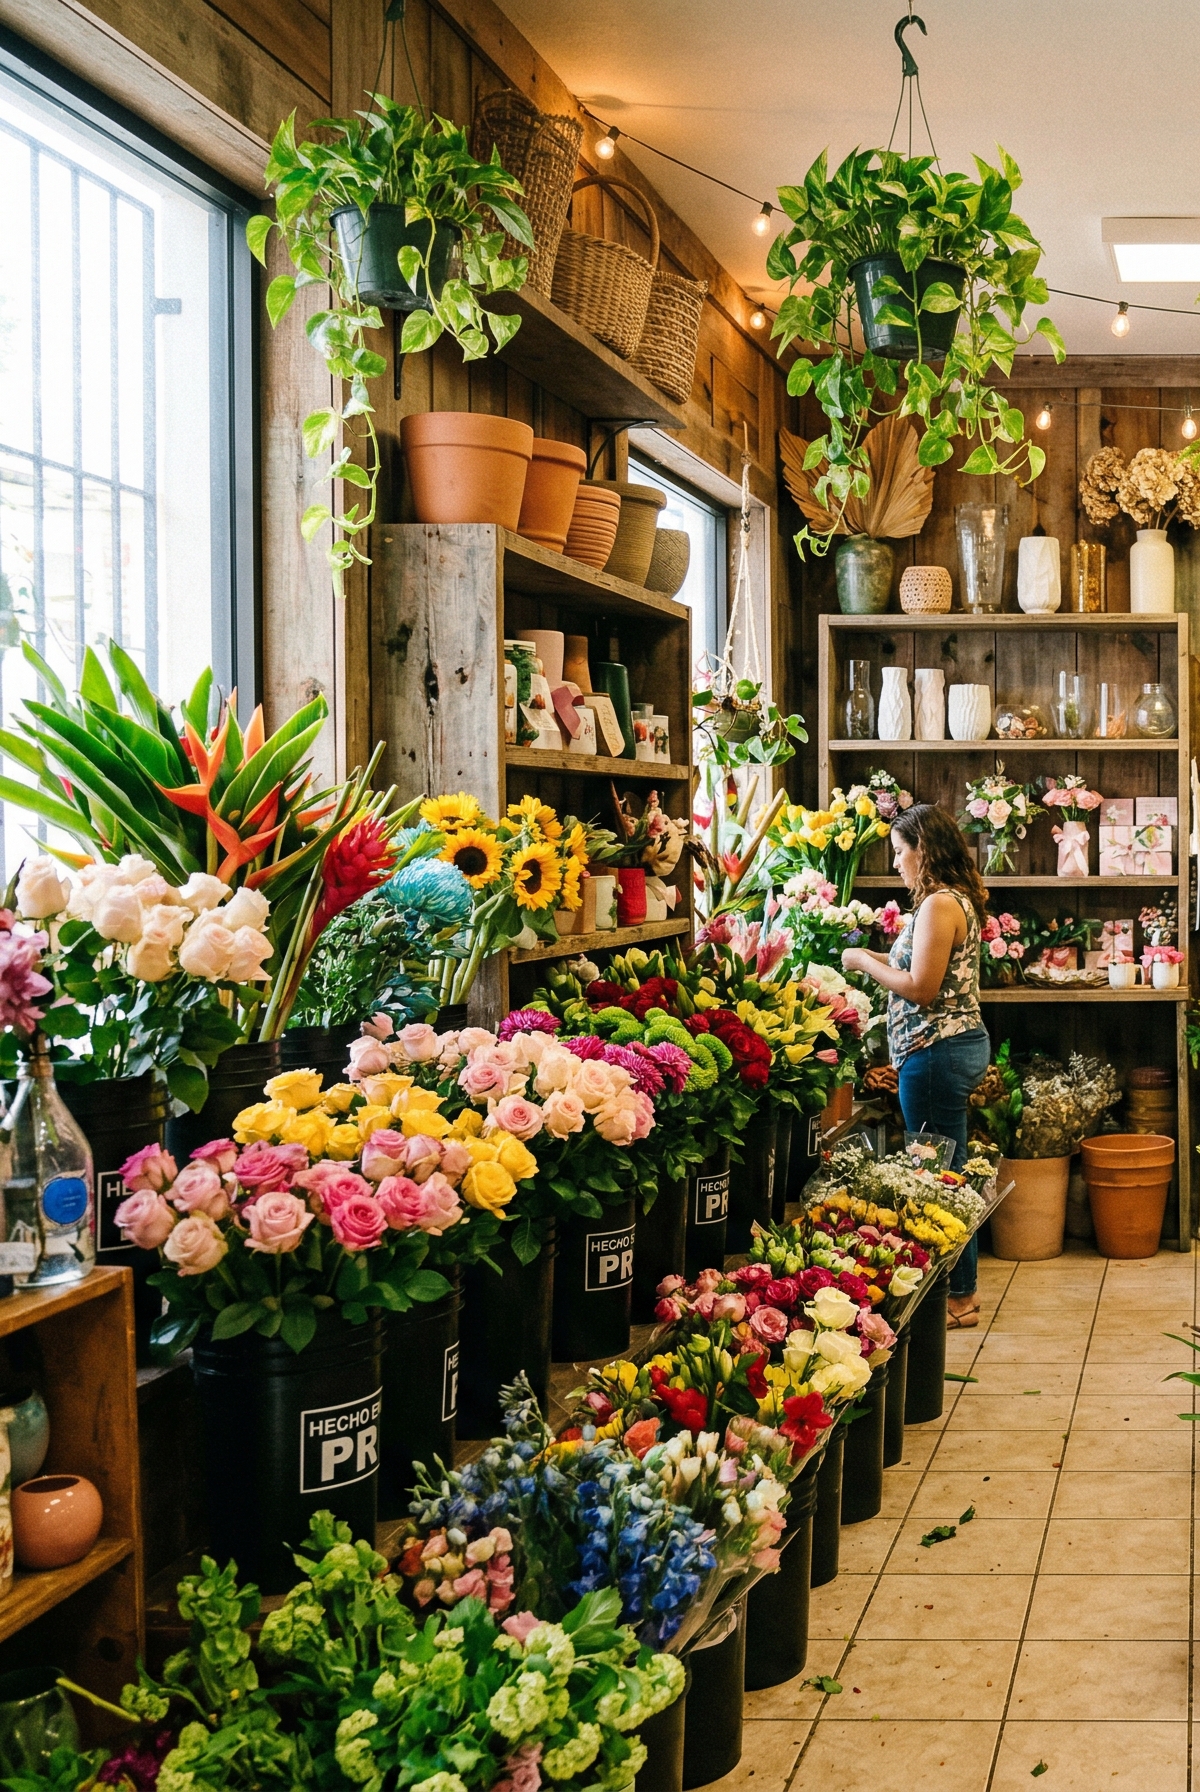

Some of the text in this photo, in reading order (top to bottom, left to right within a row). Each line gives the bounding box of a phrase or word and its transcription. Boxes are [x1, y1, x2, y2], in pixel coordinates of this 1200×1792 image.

[705, 1189, 729, 1219] PR
[591, 1236, 630, 1253] HECHO
[598, 1249, 634, 1284] PR
[309, 1407, 370, 1438] HECHO
[320, 1424, 378, 1483] PR
